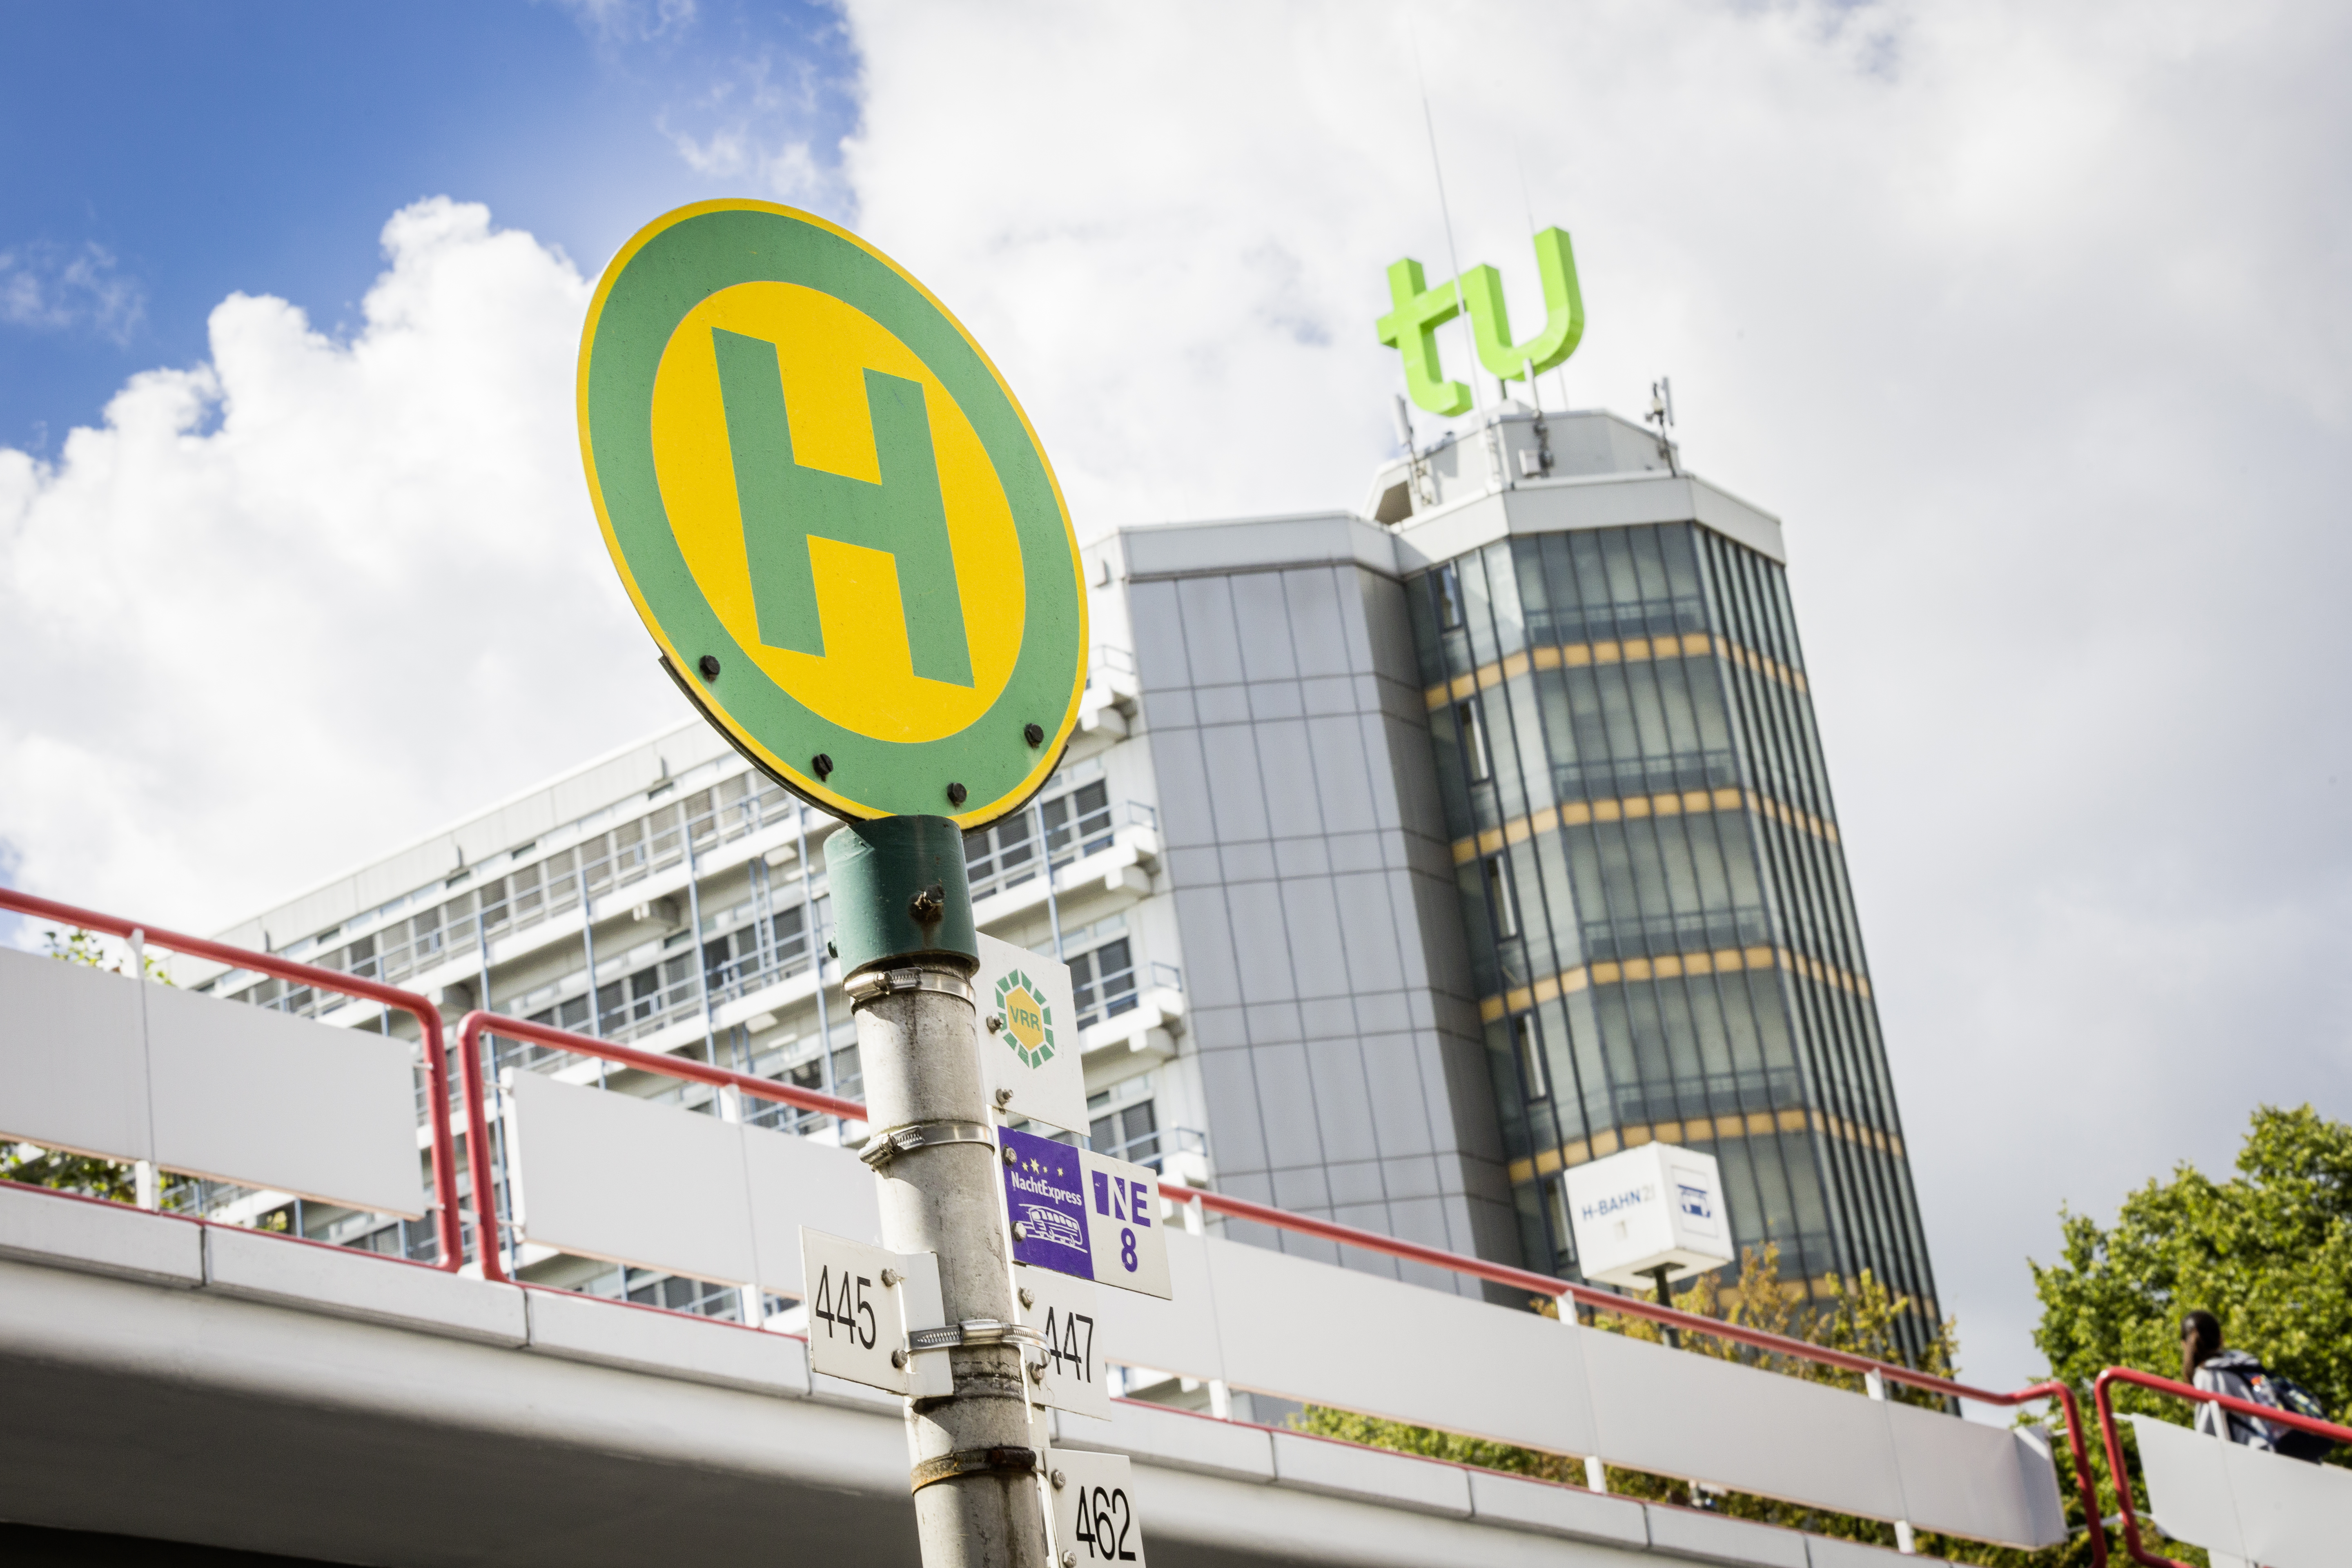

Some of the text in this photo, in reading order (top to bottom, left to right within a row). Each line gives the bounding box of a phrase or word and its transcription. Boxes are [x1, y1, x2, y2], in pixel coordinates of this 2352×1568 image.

[1377, 226, 1584, 417] tu
[712, 327, 975, 688] H
[1010, 1005, 1040, 1031] VRR
[1011, 1171, 1082, 1205] NachtExpress
[1121, 1227, 1138, 1272] 8
[816, 1265, 876, 1349] 445
[1046, 1306, 1093, 1383] 447
[1076, 1486, 1136, 1561] 462
